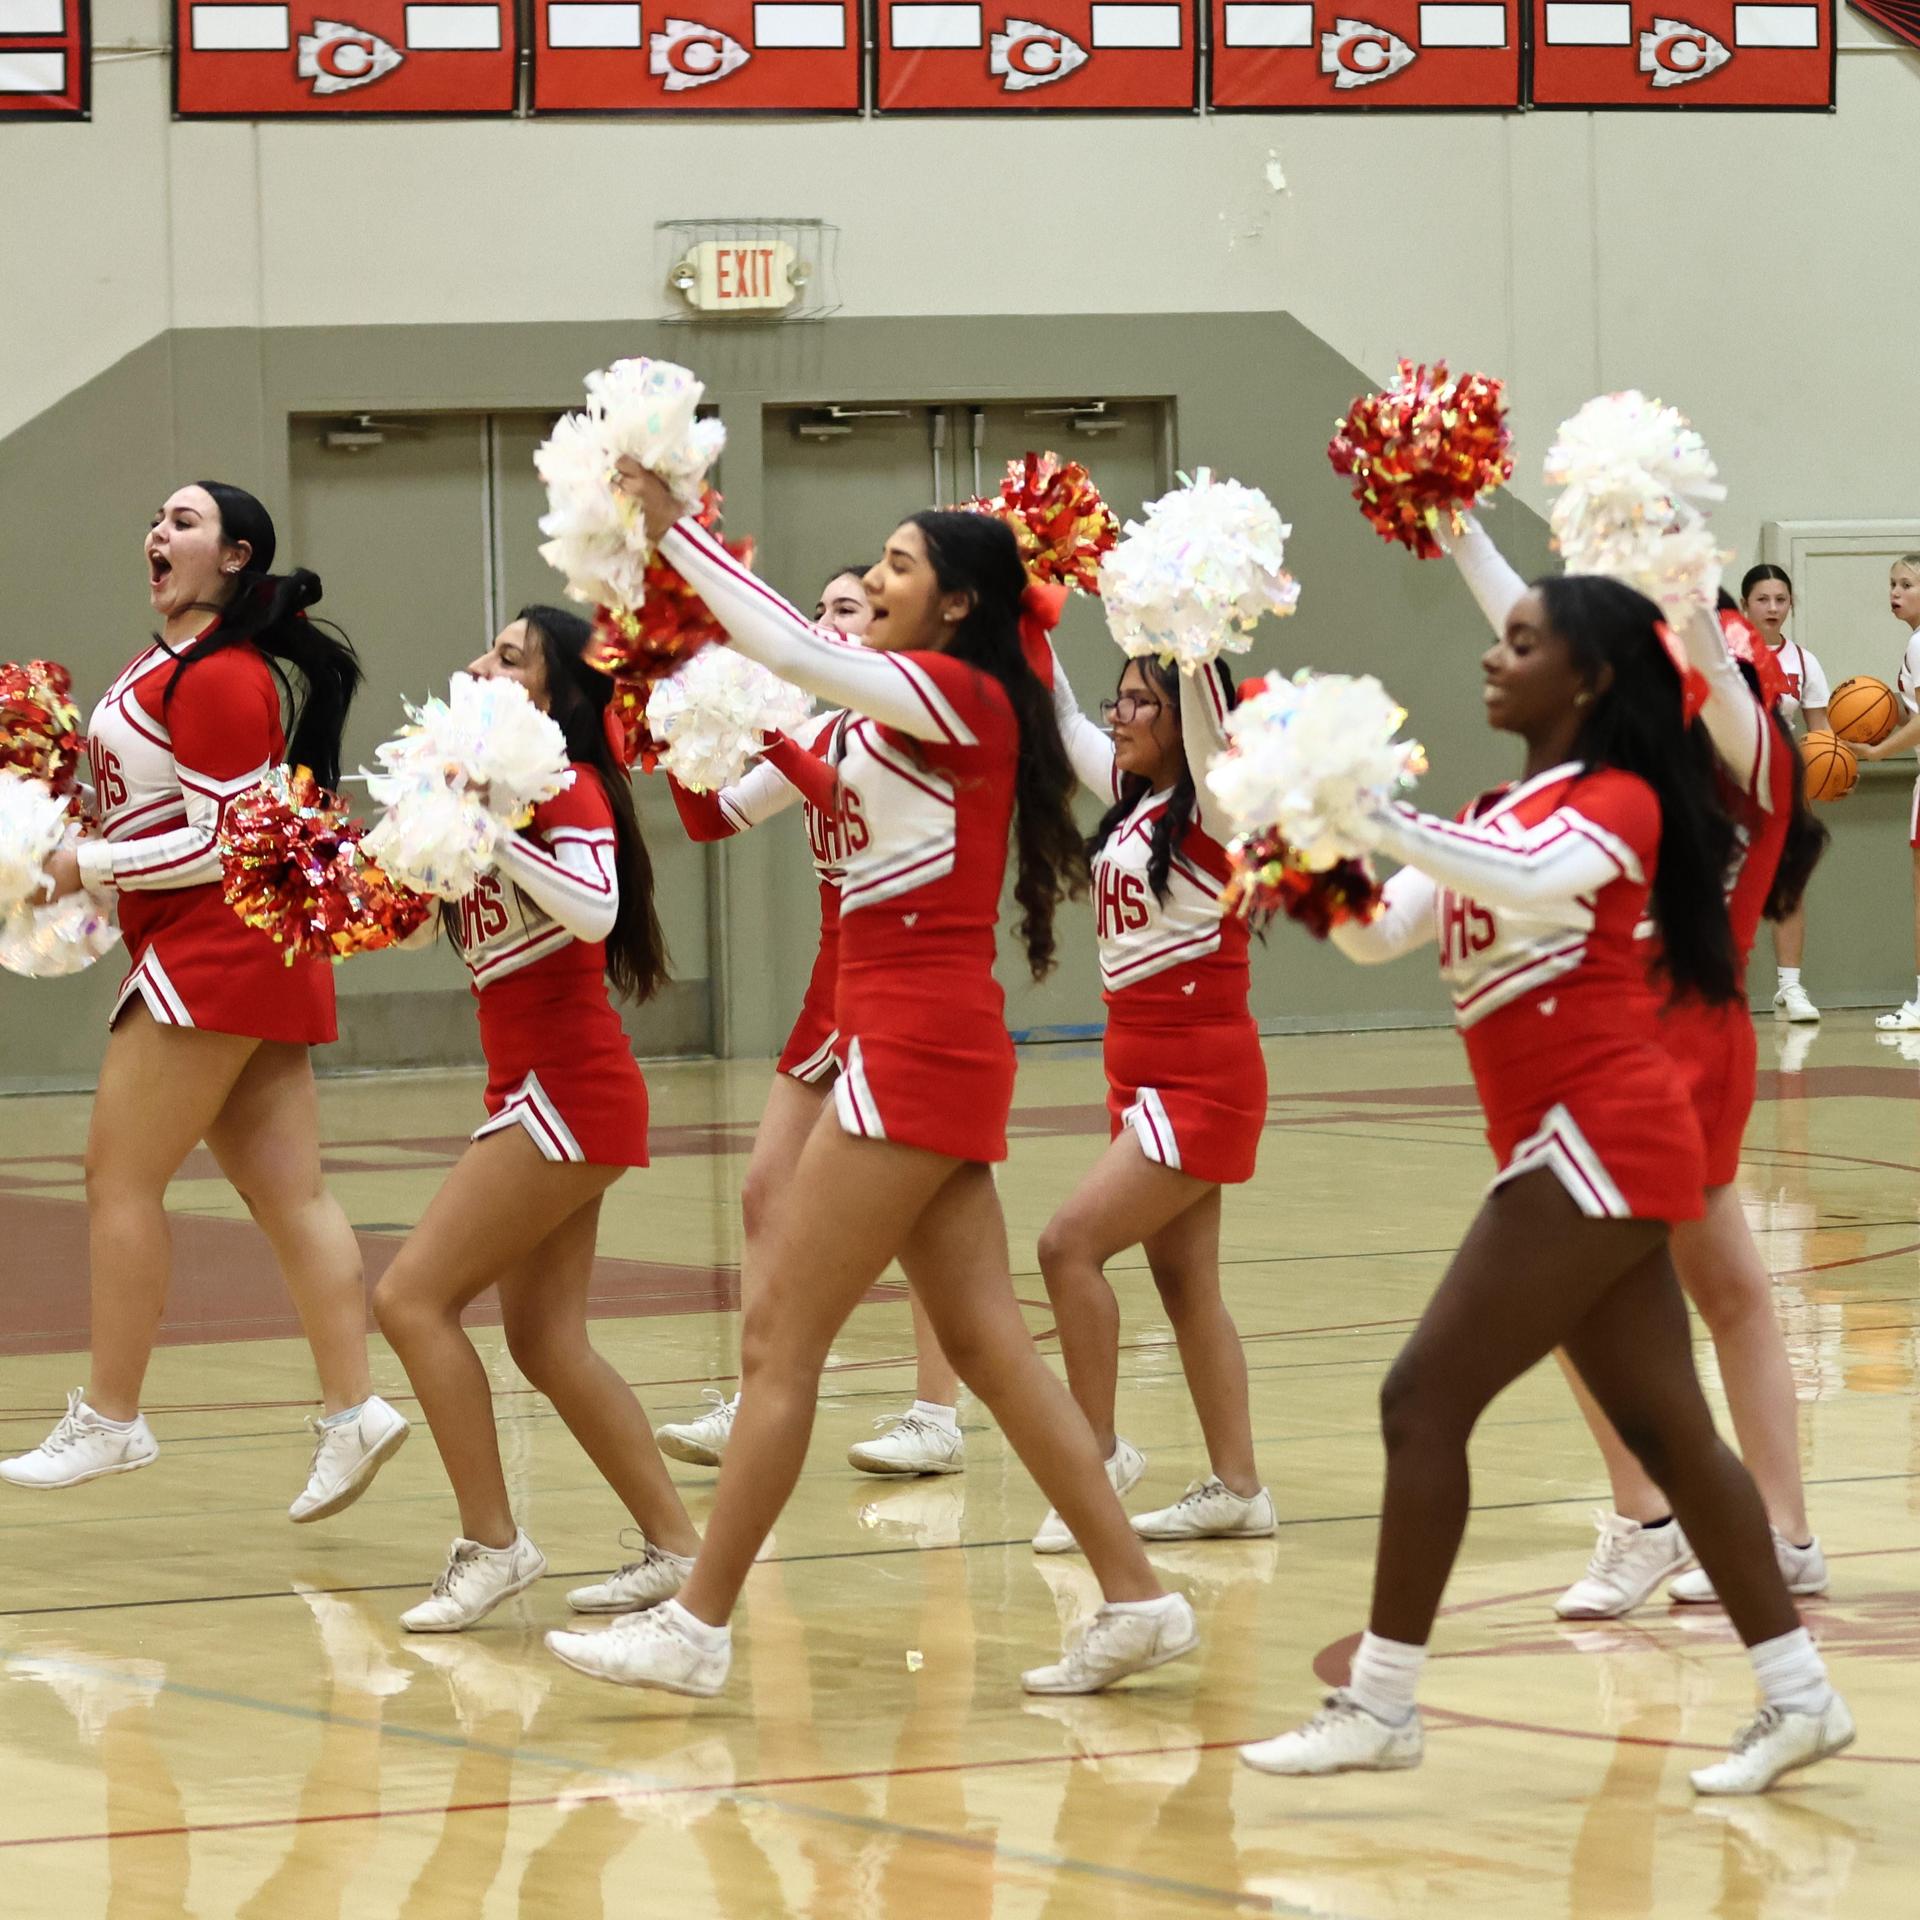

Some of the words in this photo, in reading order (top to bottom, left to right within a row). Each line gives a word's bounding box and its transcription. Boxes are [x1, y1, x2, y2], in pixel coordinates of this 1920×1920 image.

[316, 36, 374, 78] C
[667, 34, 723, 76] C
[1007, 35, 1062, 76] C
[1337, 34, 1390, 75] C
[1655, 34, 1707, 73] C
[716, 248, 773, 298] EXIT
